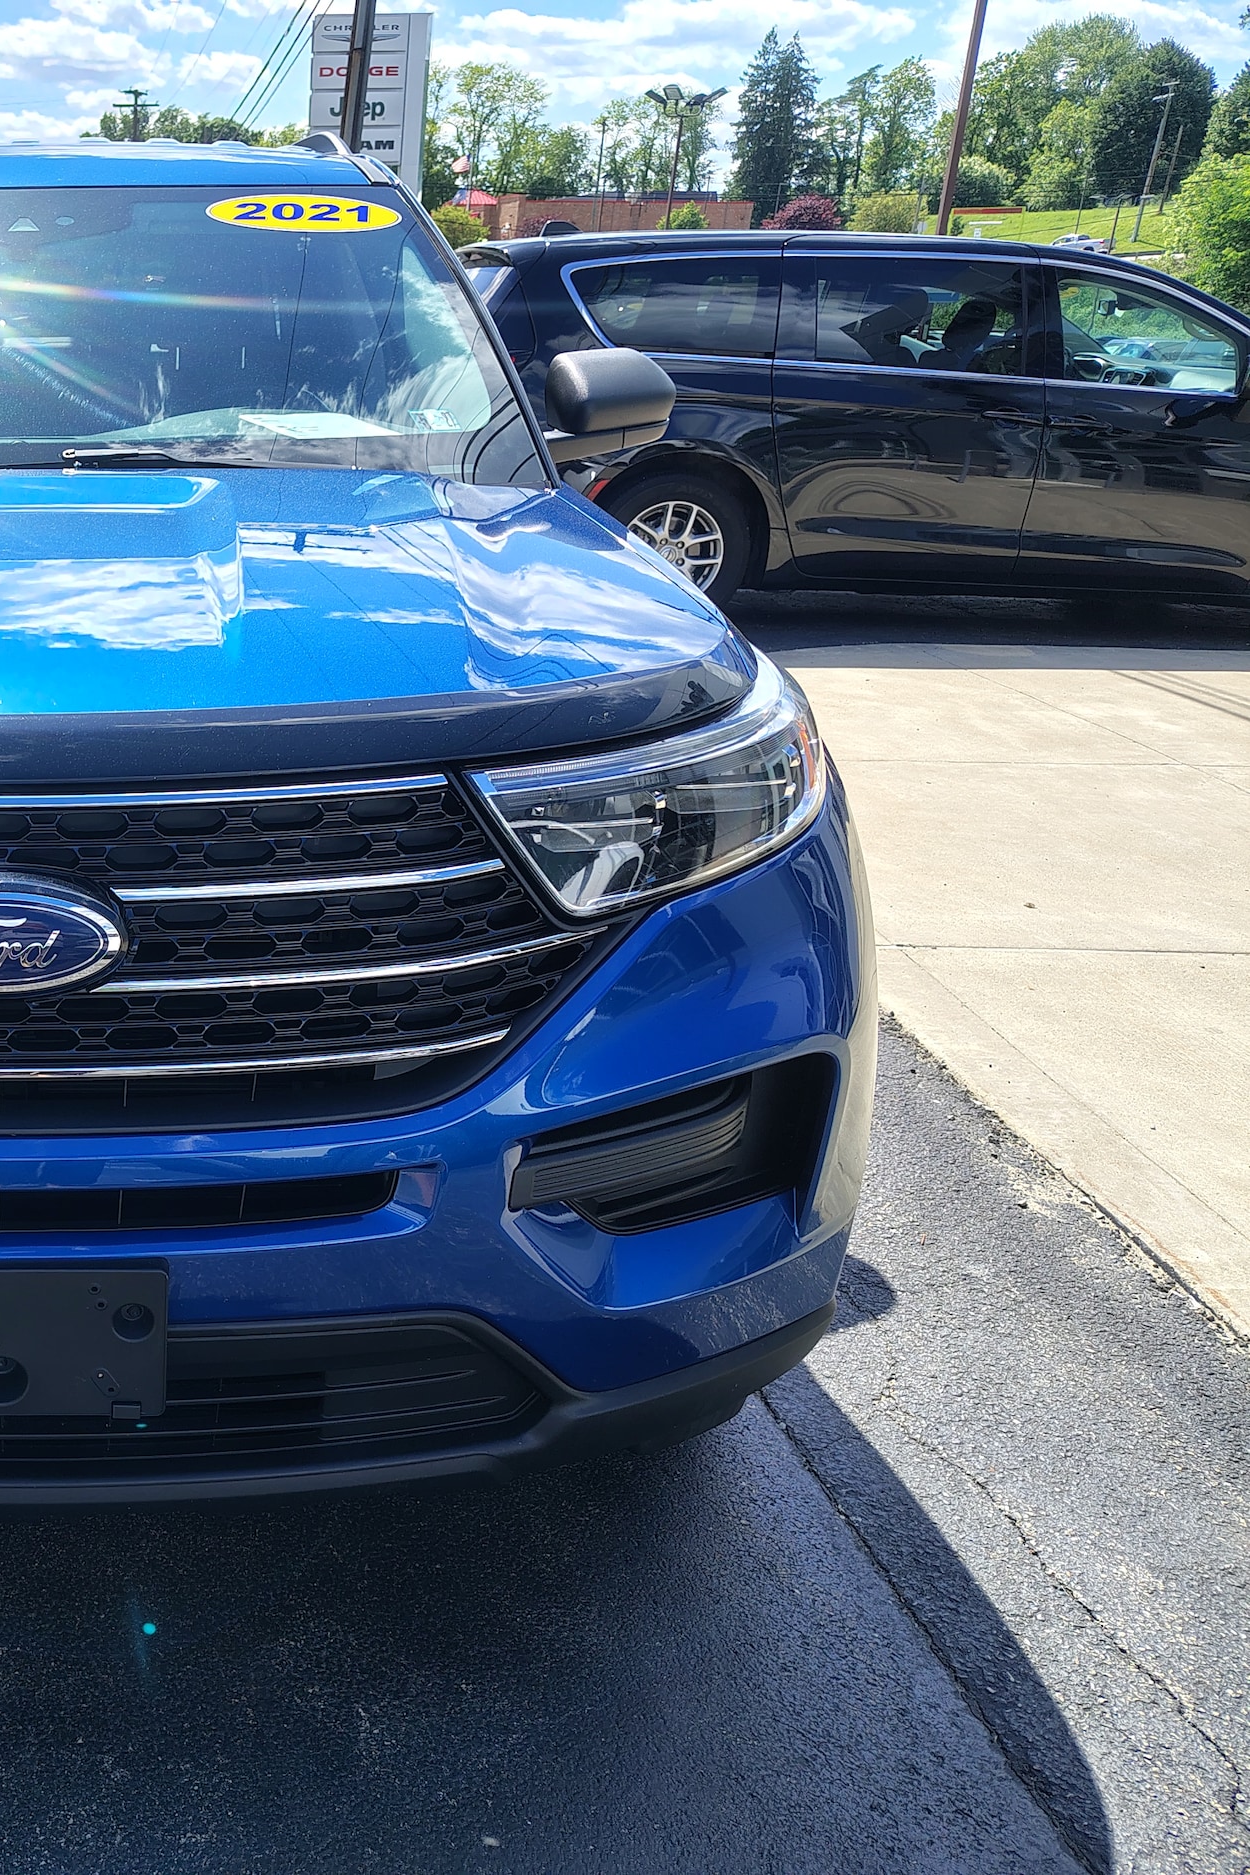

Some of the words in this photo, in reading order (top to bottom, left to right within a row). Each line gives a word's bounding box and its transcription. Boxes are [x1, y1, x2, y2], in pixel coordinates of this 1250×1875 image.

[323, 24, 400, 32] CHRLER
[319, 66, 399, 77] DOGE
[329, 96, 385, 121] Jep
[358, 140, 395, 150] AM
[233, 202, 370, 223] 2021
